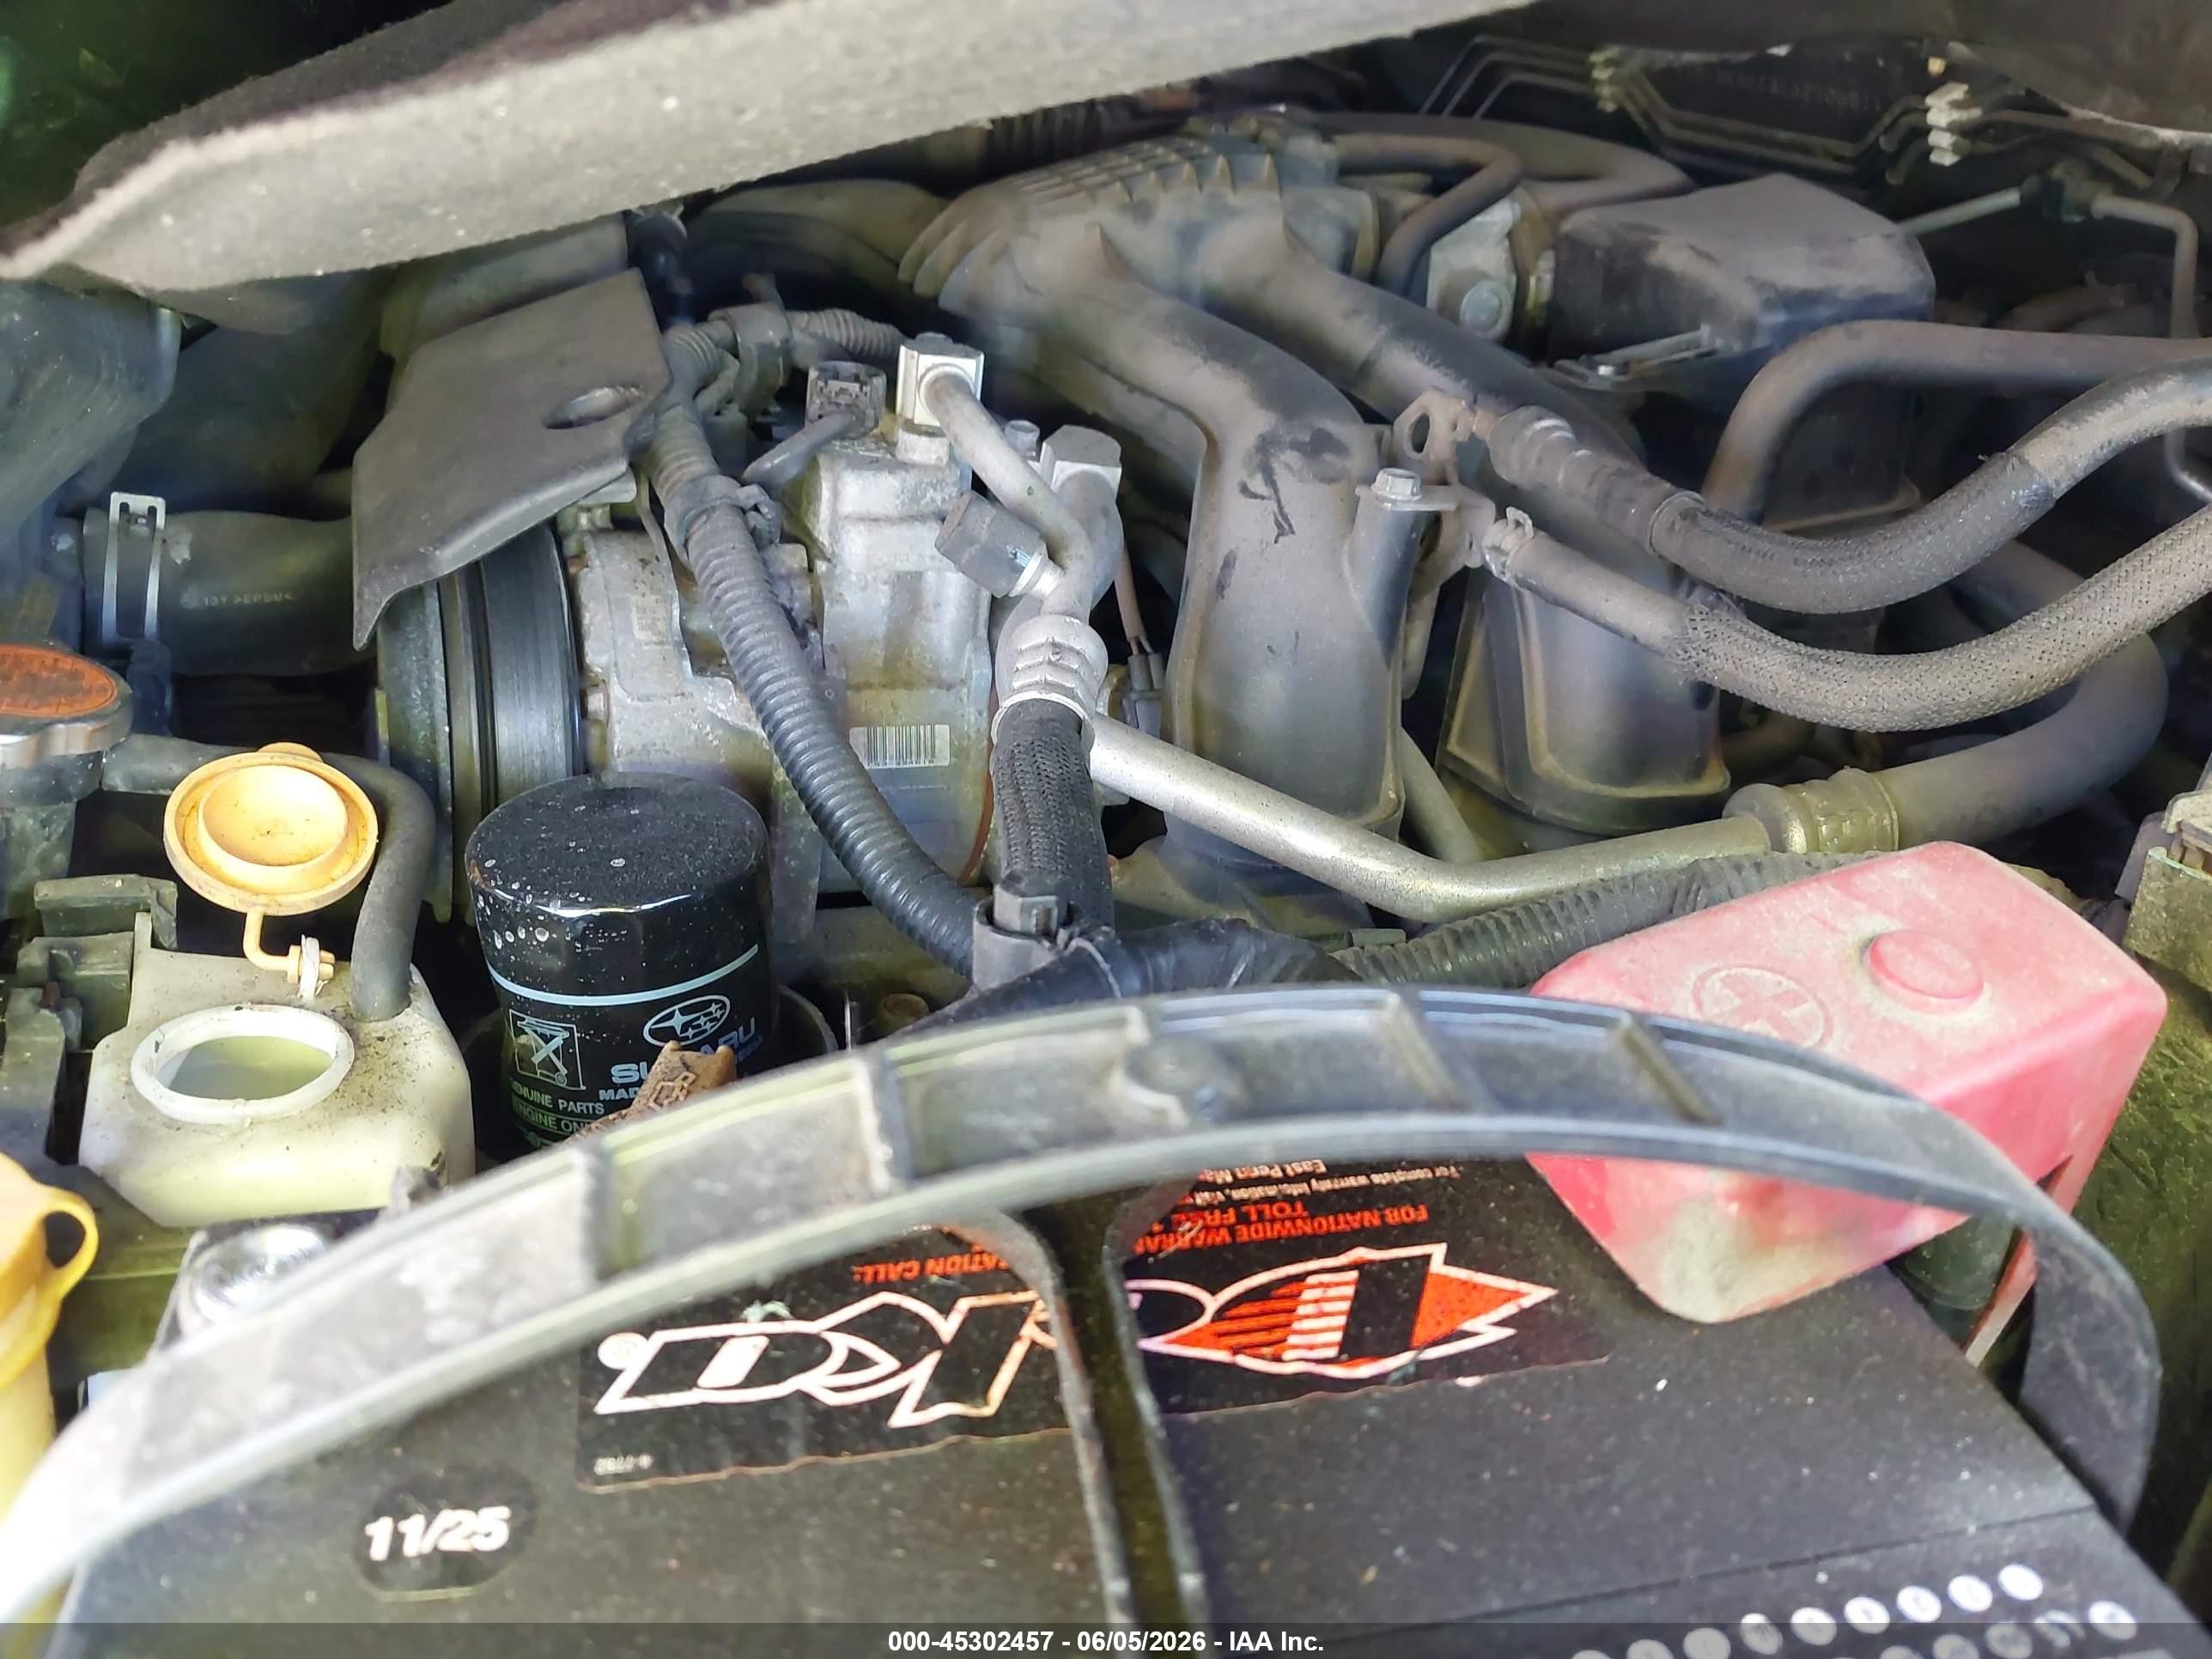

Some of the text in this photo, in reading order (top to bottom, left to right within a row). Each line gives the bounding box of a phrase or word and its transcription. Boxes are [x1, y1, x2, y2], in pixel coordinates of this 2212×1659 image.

[599, 1088, 641, 1102] MAD
[558, 1099, 605, 1115] PARTS
[1241, 1200, 1309, 1221] TOLL
[1384, 1203, 1429, 1225] FOR
[1234, 1207, 1382, 1244] NATIONWIDE
[851, 1257, 921, 1285] CALL:
[363, 1504, 512, 1562] 11/25
